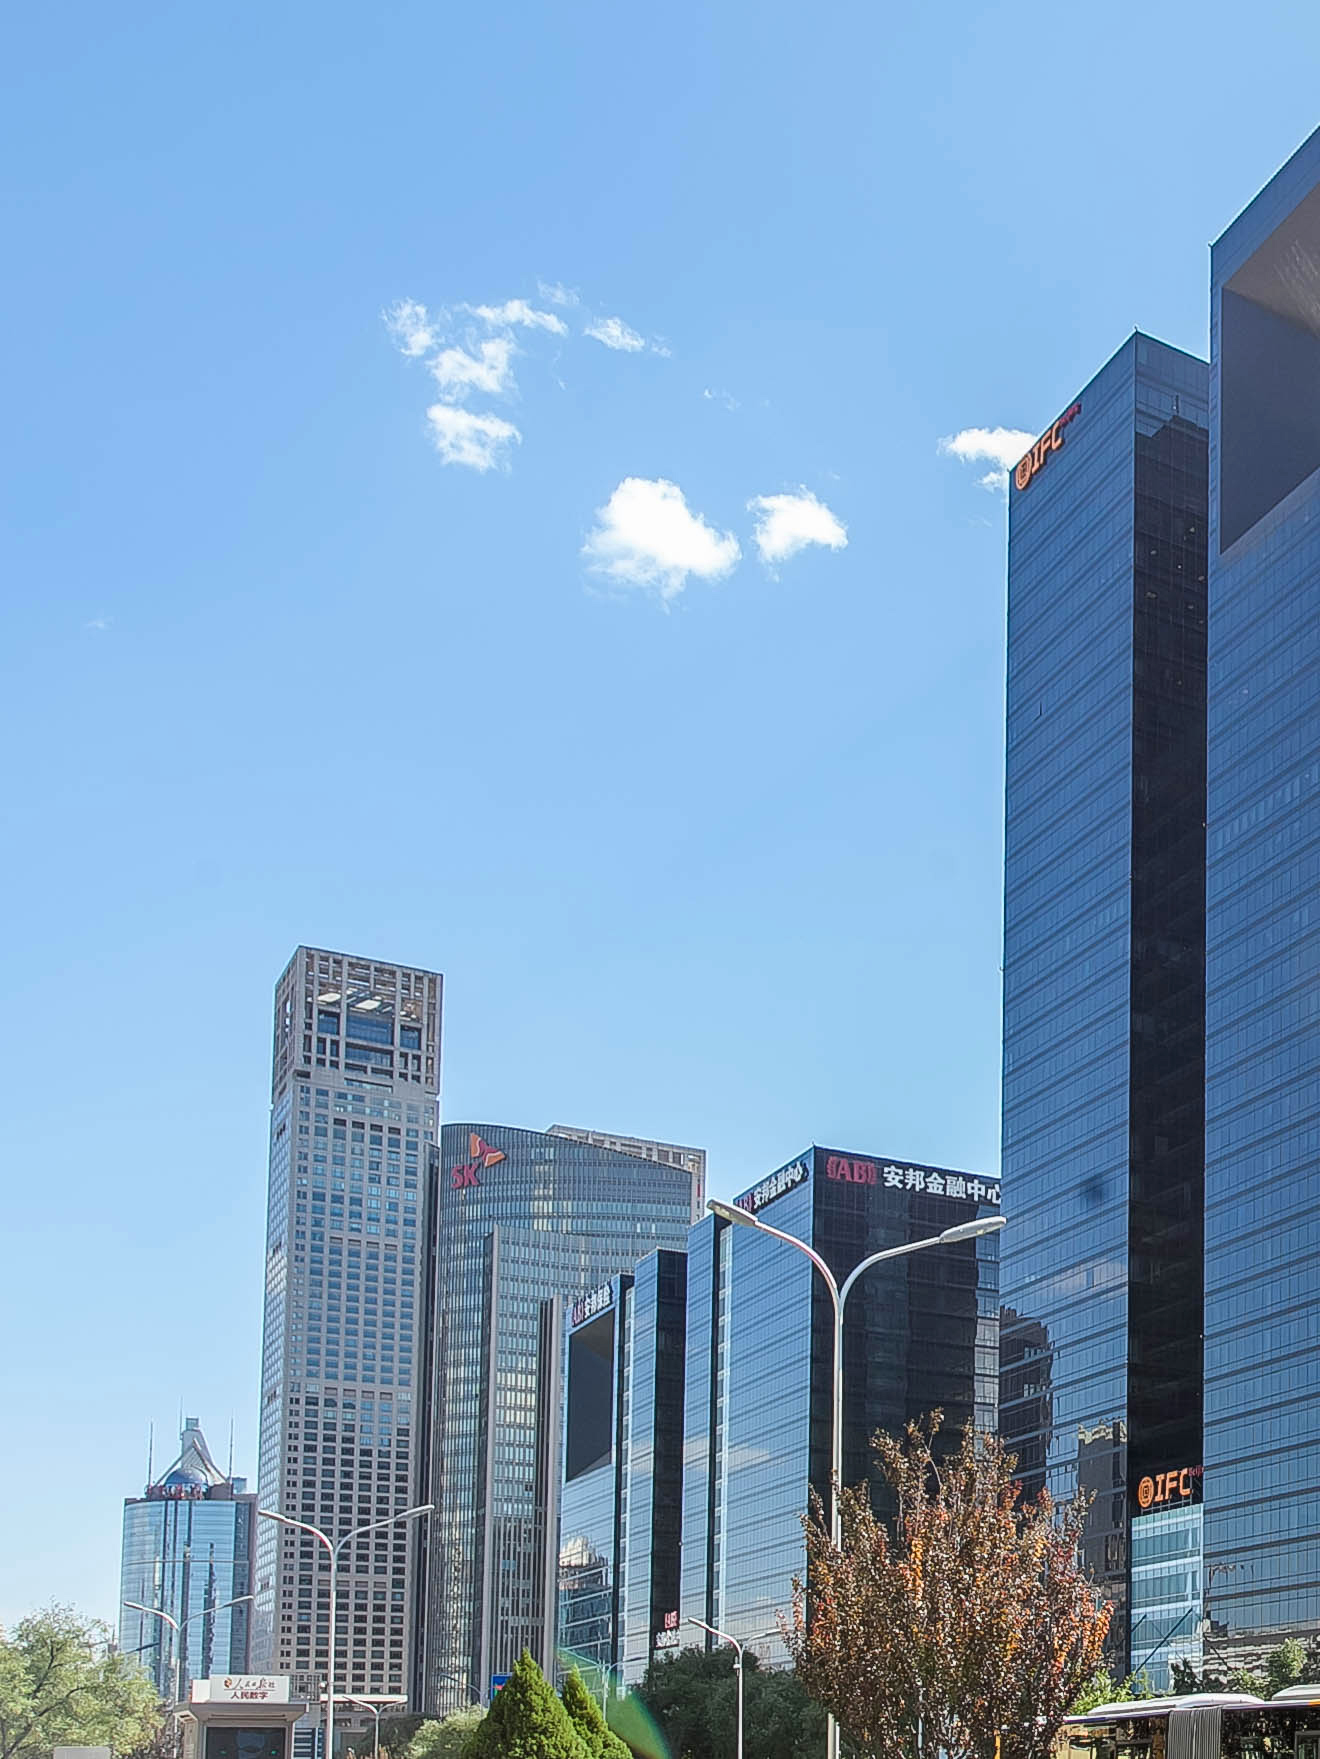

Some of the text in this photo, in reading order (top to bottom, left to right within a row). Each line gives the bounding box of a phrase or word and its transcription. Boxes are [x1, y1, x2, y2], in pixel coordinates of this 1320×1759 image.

[1031, 420, 1063, 474] IFC
[451, 1161, 480, 1189] SK
[883, 1165, 1001, 1204] 安邦金融中心
[1154, 1468, 1191, 1502] IFC
